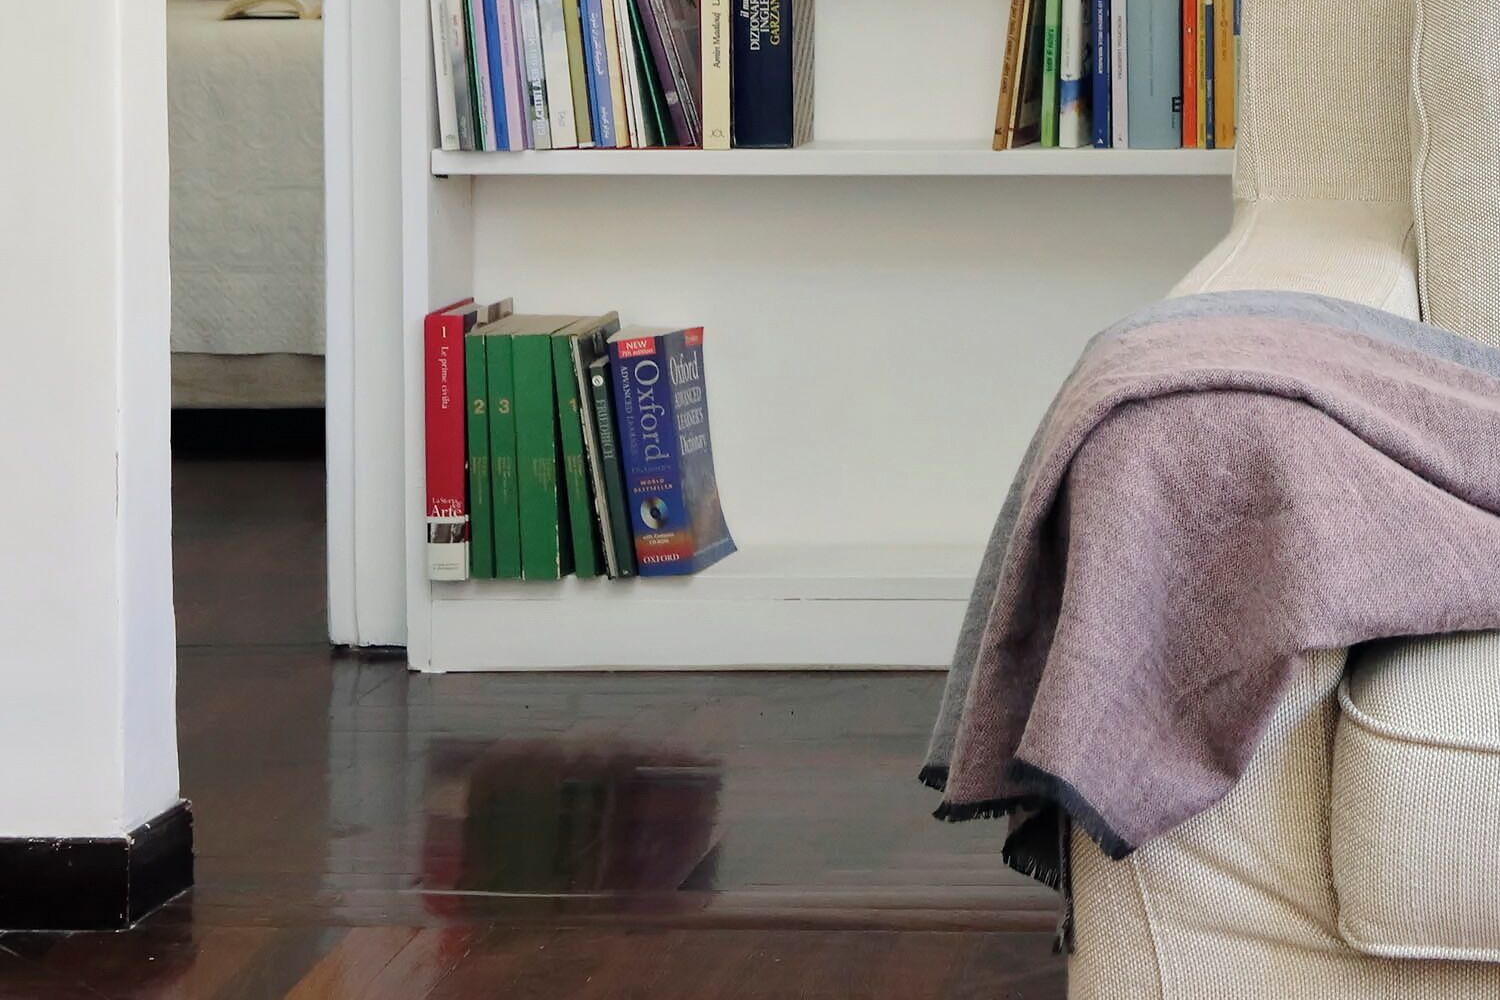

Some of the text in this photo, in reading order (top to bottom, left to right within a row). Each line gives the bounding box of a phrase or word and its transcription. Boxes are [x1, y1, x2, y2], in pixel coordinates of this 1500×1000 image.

[740, 9, 749, 19] il
[712, 13, 720, 42] Maalouf
[440, 326, 447, 338] 1
[440, 346, 449, 357] Le
[626, 340, 648, 350] NEW
[438, 358, 449, 383] prime
[670, 351, 700, 385] Oxford
[620, 366, 633, 414] ADVANCED
[675, 386, 702, 408] ADVANCED
[474, 399, 485, 414] 2
[498, 399, 510, 414] 3
[634, 360, 672, 462] Oxford
[596, 400, 615, 460] FRIEDRICH
[680, 434, 707, 456] Dictionary
[633, 484, 673, 494] BESTSELLER
[640, 478, 665, 486] WORLD
[431, 504, 462, 518] Arte
[643, 553, 680, 565] OXFORD
